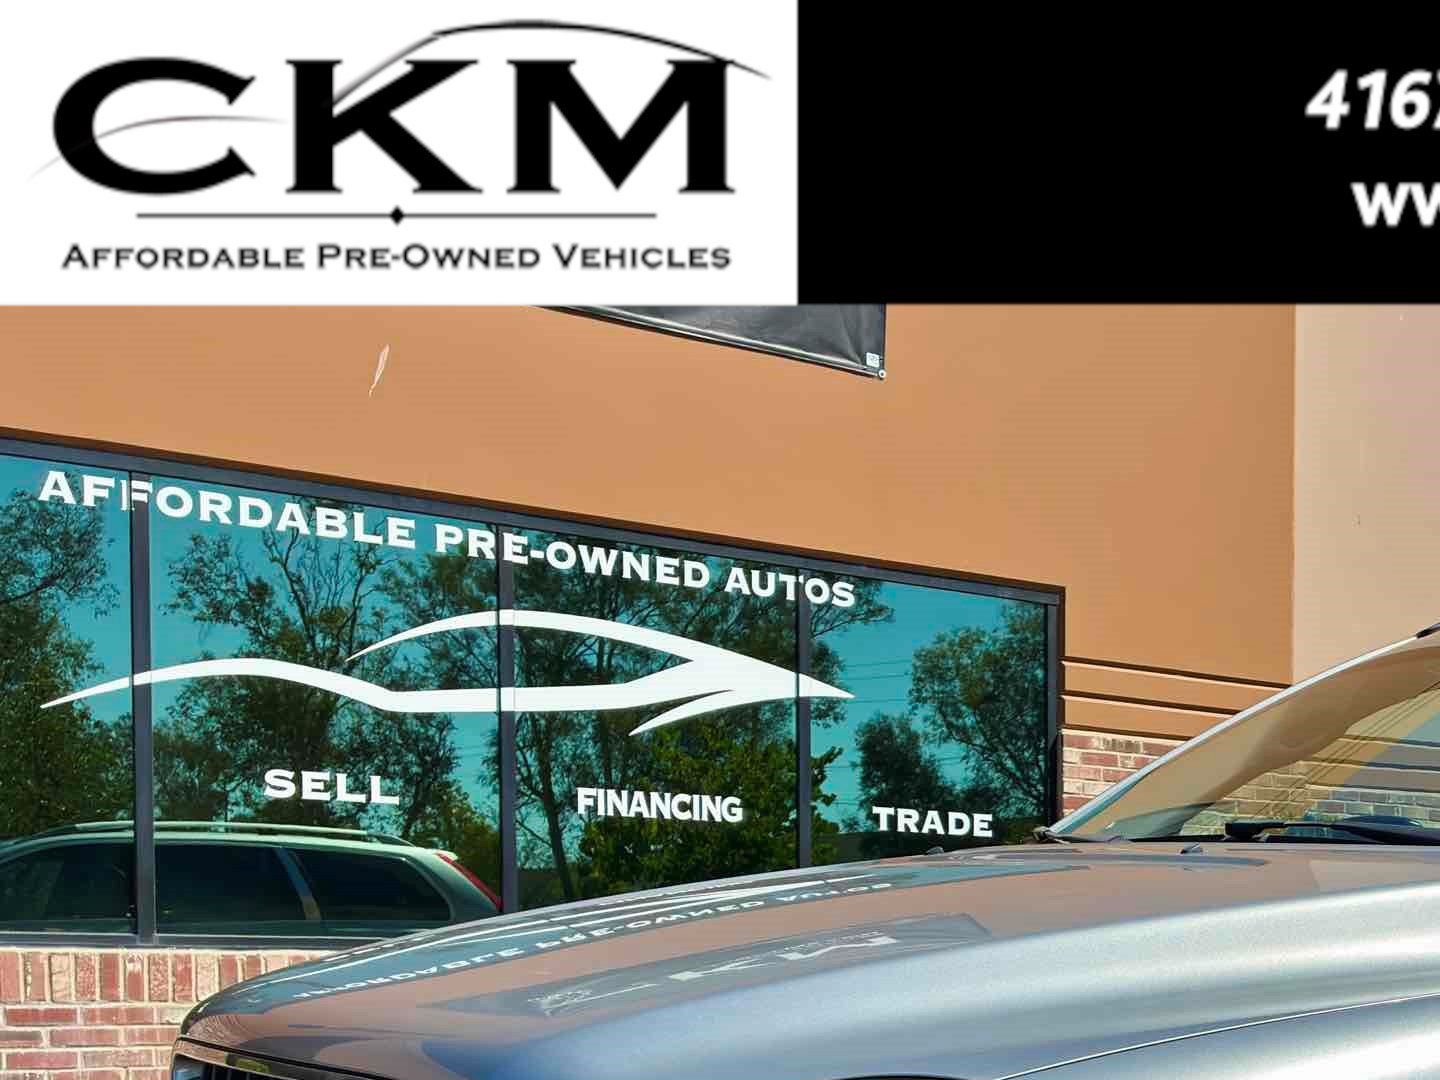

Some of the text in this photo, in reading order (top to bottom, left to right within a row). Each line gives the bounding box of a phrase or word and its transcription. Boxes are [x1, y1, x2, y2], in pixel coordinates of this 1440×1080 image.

[38, 469, 857, 608] AFFORDABLE PRE-OWNED AUTOS
[263, 768, 401, 805] SELL
[576, 786, 745, 823] FINANCING
[871, 805, 994, 838] TRADE
